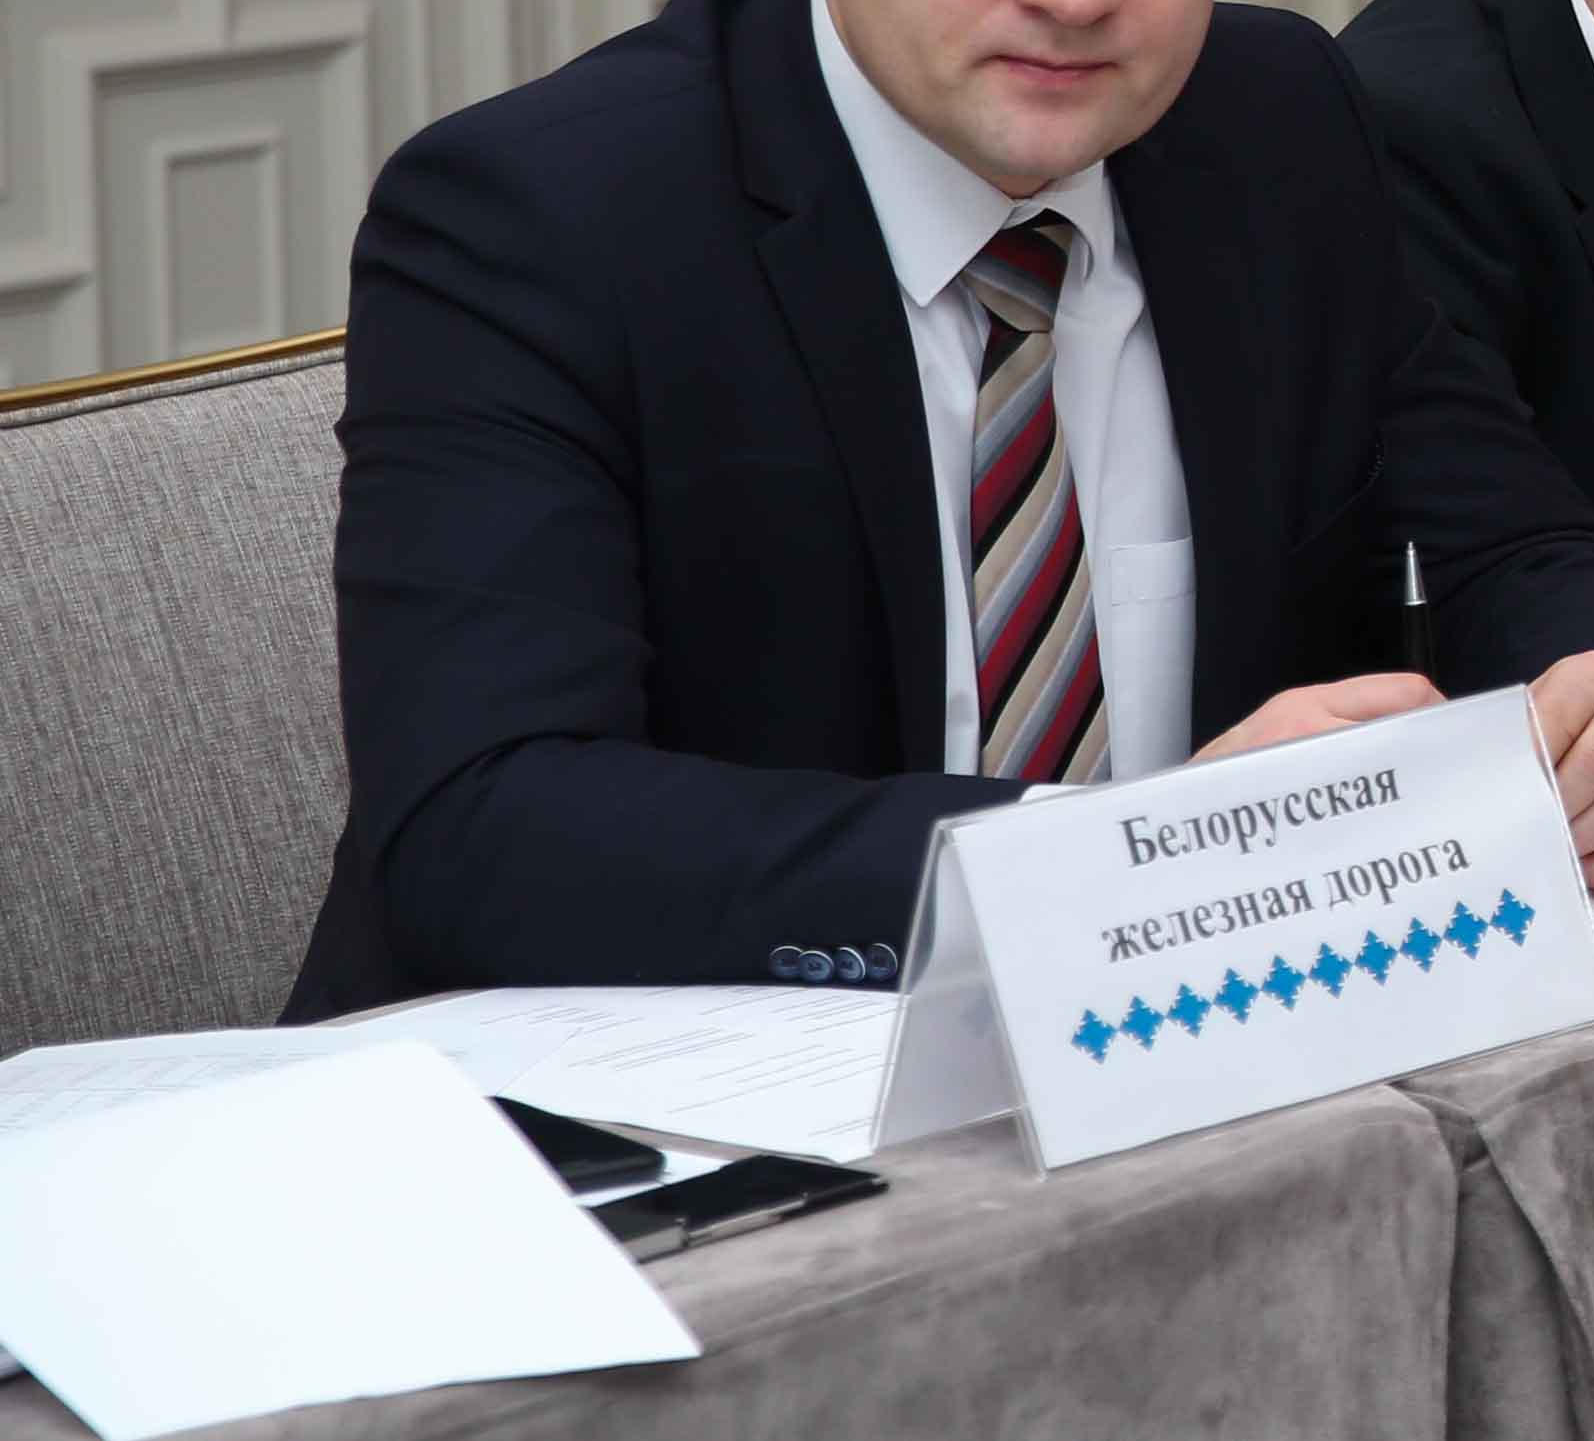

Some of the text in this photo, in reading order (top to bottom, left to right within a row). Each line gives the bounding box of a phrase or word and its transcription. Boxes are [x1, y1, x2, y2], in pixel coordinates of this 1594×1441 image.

[1119, 767, 1401, 868] Белорусская
[1101, 837, 1471, 963] железная дорога
